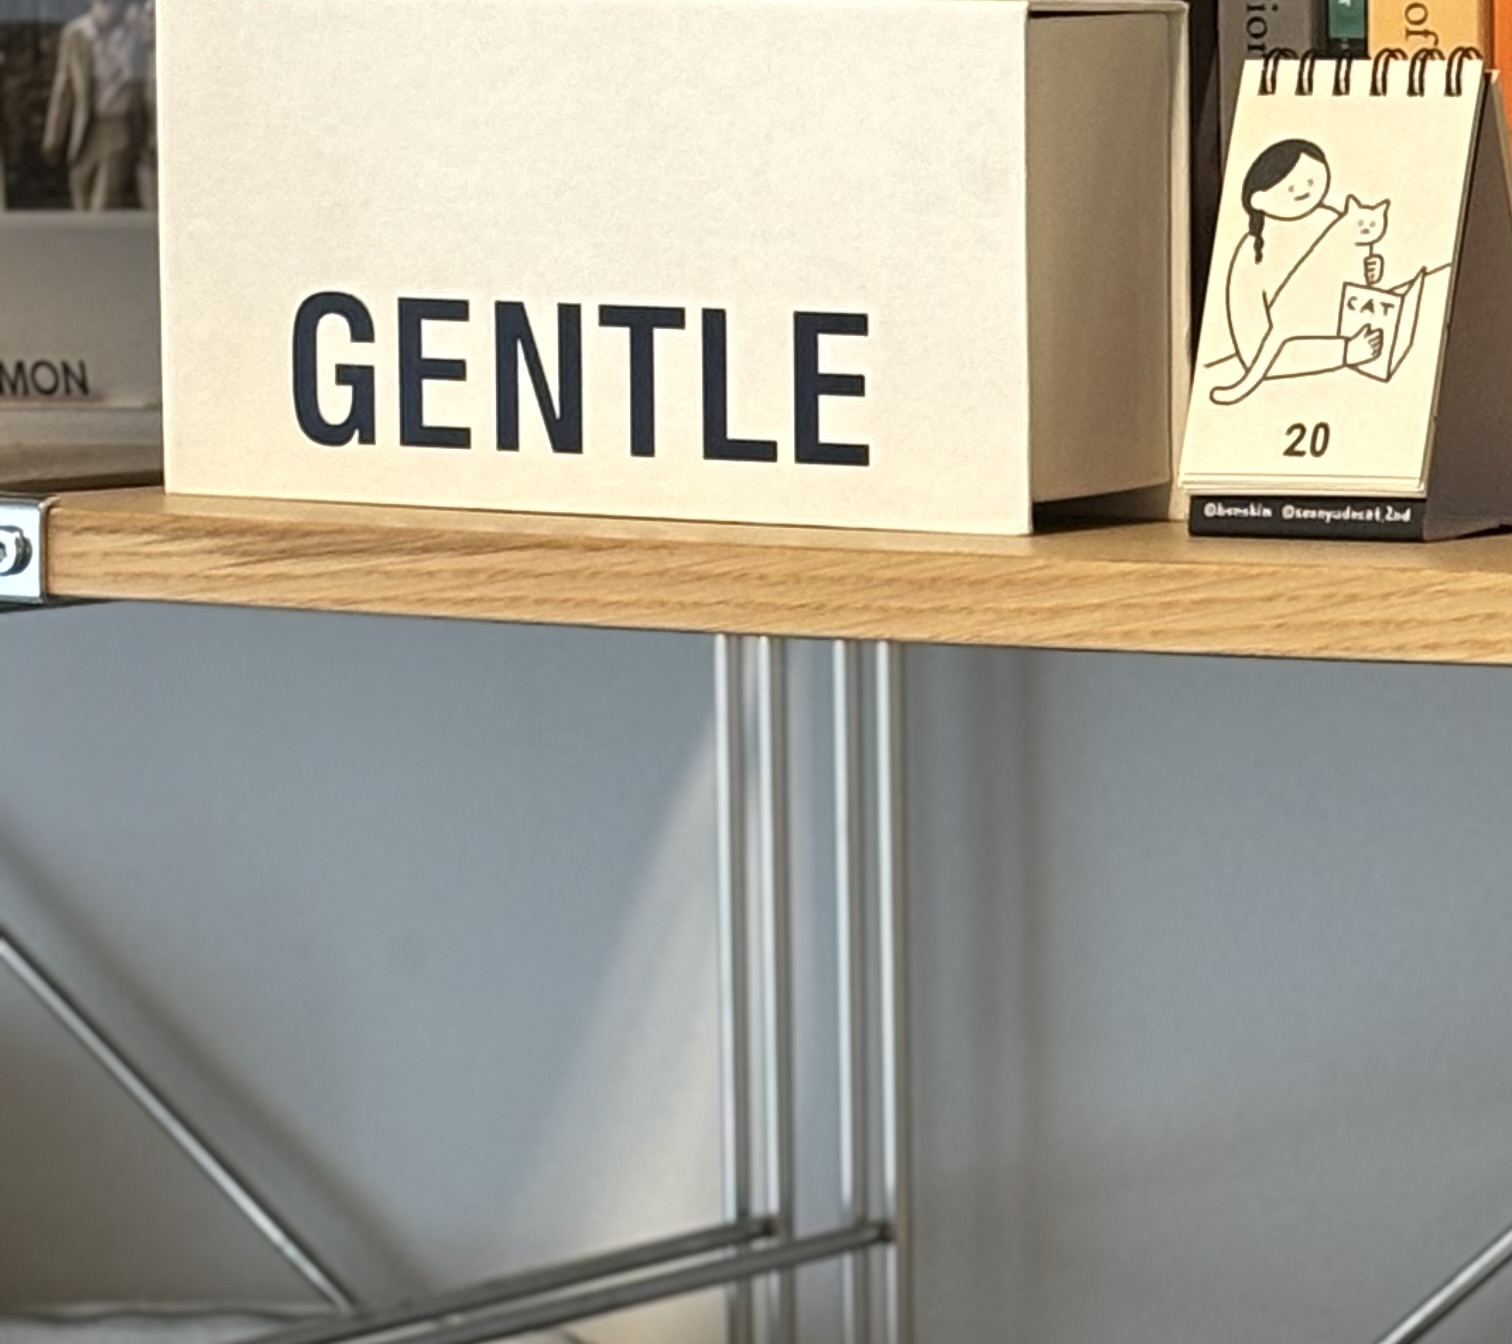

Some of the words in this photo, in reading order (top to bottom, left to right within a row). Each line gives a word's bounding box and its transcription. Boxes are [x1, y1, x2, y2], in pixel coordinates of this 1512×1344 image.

[1404, 3, 1440, 47] of
[0, 359, 90, 396] MON
[289, 290, 871, 468] GENTLE
[1282, 421, 1331, 458] 20
